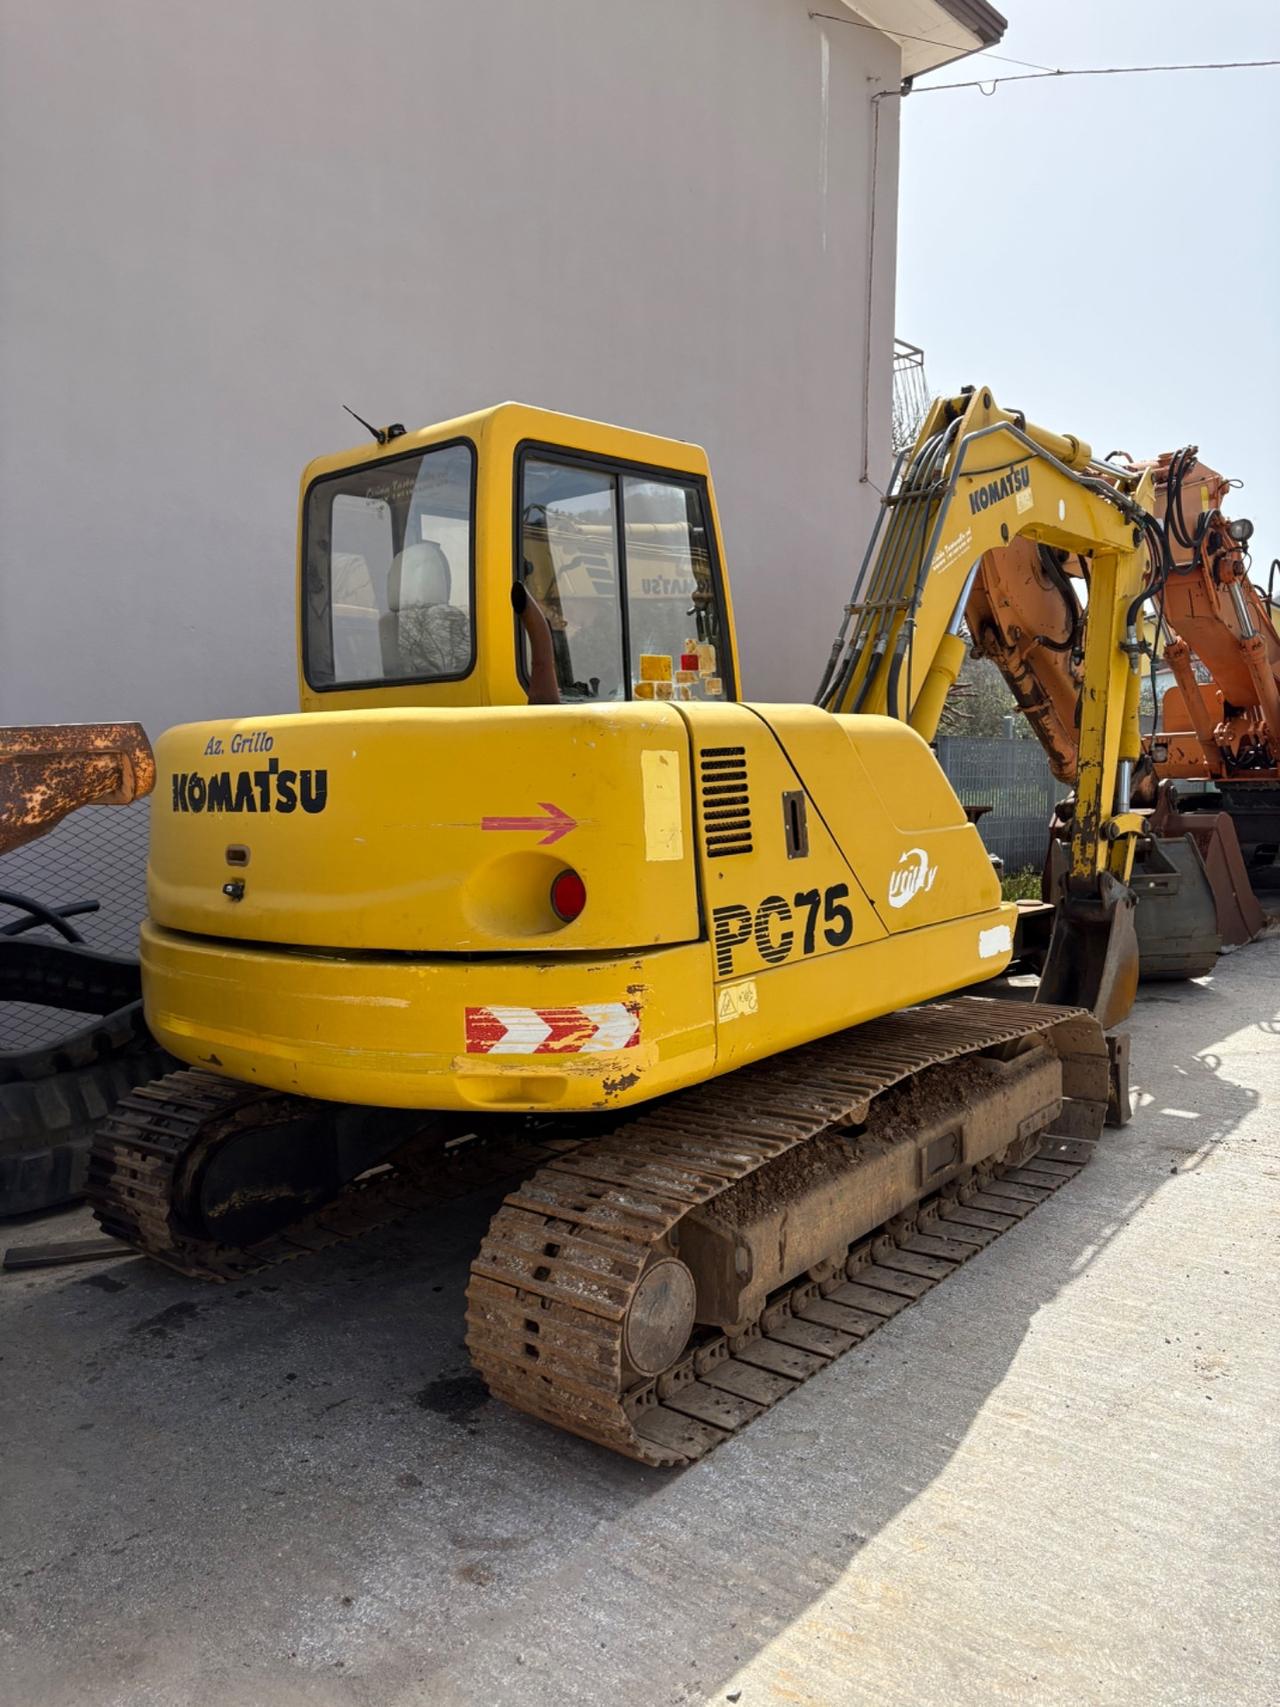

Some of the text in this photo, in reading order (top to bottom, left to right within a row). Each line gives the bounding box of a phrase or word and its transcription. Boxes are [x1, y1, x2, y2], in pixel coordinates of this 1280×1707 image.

[969, 464, 1030, 515] KOMATSU
[204, 732, 273, 756] Az. Grillo
[172, 757, 328, 814] KOMATSU
[889, 862, 938, 897] Utilty
[712, 882, 854, 976] PC75
